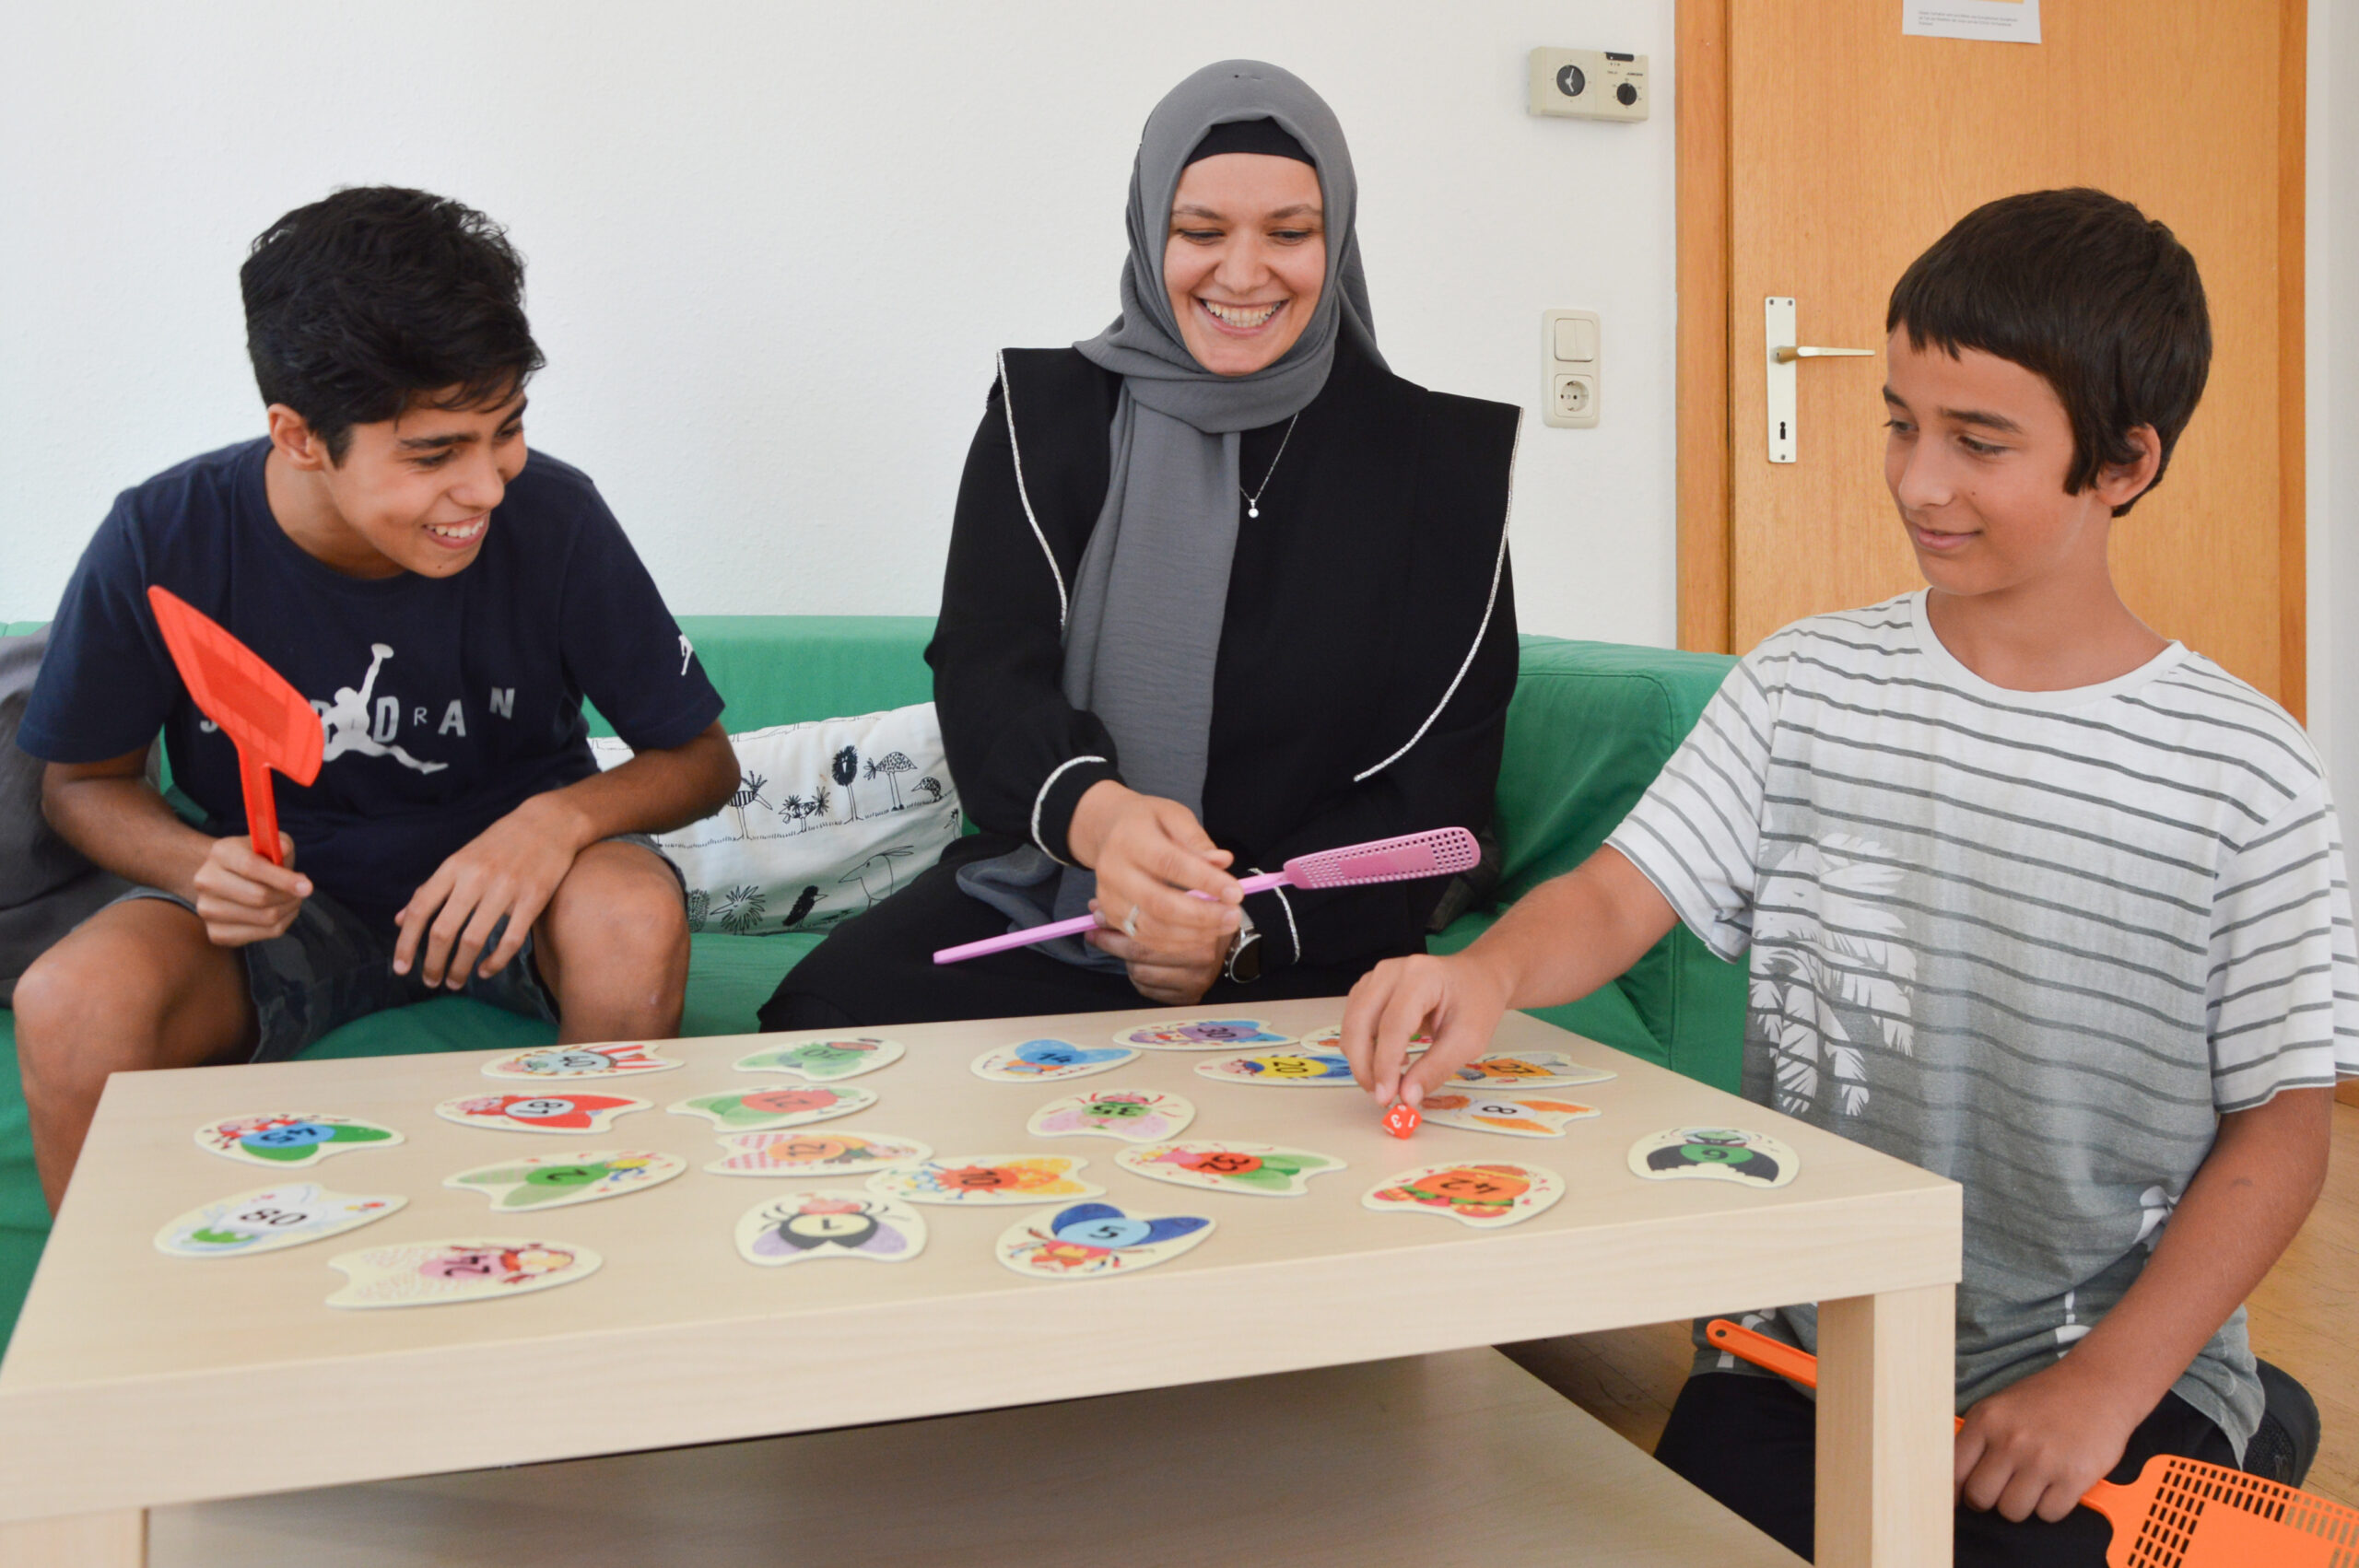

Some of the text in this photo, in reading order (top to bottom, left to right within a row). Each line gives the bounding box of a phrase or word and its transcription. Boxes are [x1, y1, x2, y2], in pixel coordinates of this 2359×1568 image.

[1197, 1027, 1237, 1038] 30
[1038, 1053, 1073, 1063] 14
[1273, 1060, 1309, 1073] 20
[1093, 1104, 1136, 1117] 35
[1482, 1106, 1517, 1114] 8
[1390, 1113, 1402, 1129] 3
[1407, 1113, 1417, 1128] 1
[261, 1128, 317, 1142] 45
[786, 1142, 827, 1158] 12
[1198, 1155, 1250, 1172] 32
[546, 1169, 588, 1181] 2
[959, 1170, 1003, 1187] 10
[241, 1211, 307, 1225] 80
[821, 1218, 843, 1232] 1
[1088, 1225, 1128, 1241] 5
